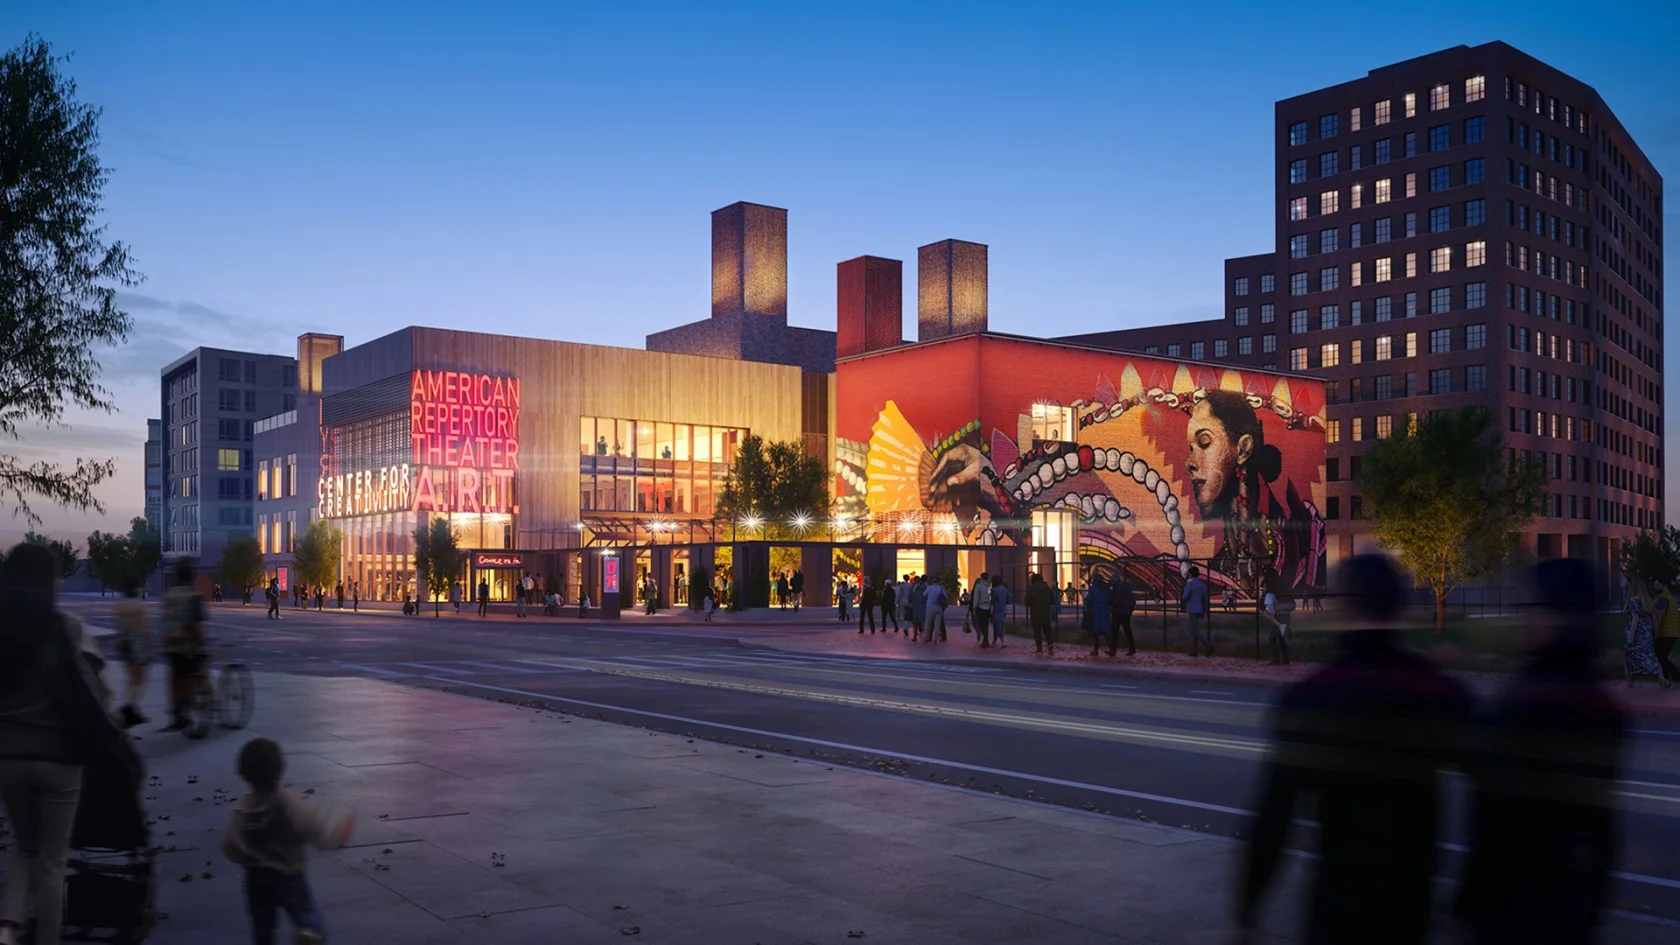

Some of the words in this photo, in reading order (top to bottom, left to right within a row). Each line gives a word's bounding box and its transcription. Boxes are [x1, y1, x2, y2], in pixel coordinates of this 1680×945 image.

[411, 369, 520, 408] AMERICAN
[411, 402, 520, 438] REPERTORY
[411, 433, 520, 469] THEATER
[318, 470, 373, 499] CENTER
[381, 463, 410, 491] FOR
[411, 465, 520, 514] A.R.T.
[318, 487, 410, 519] CREATIVITY
